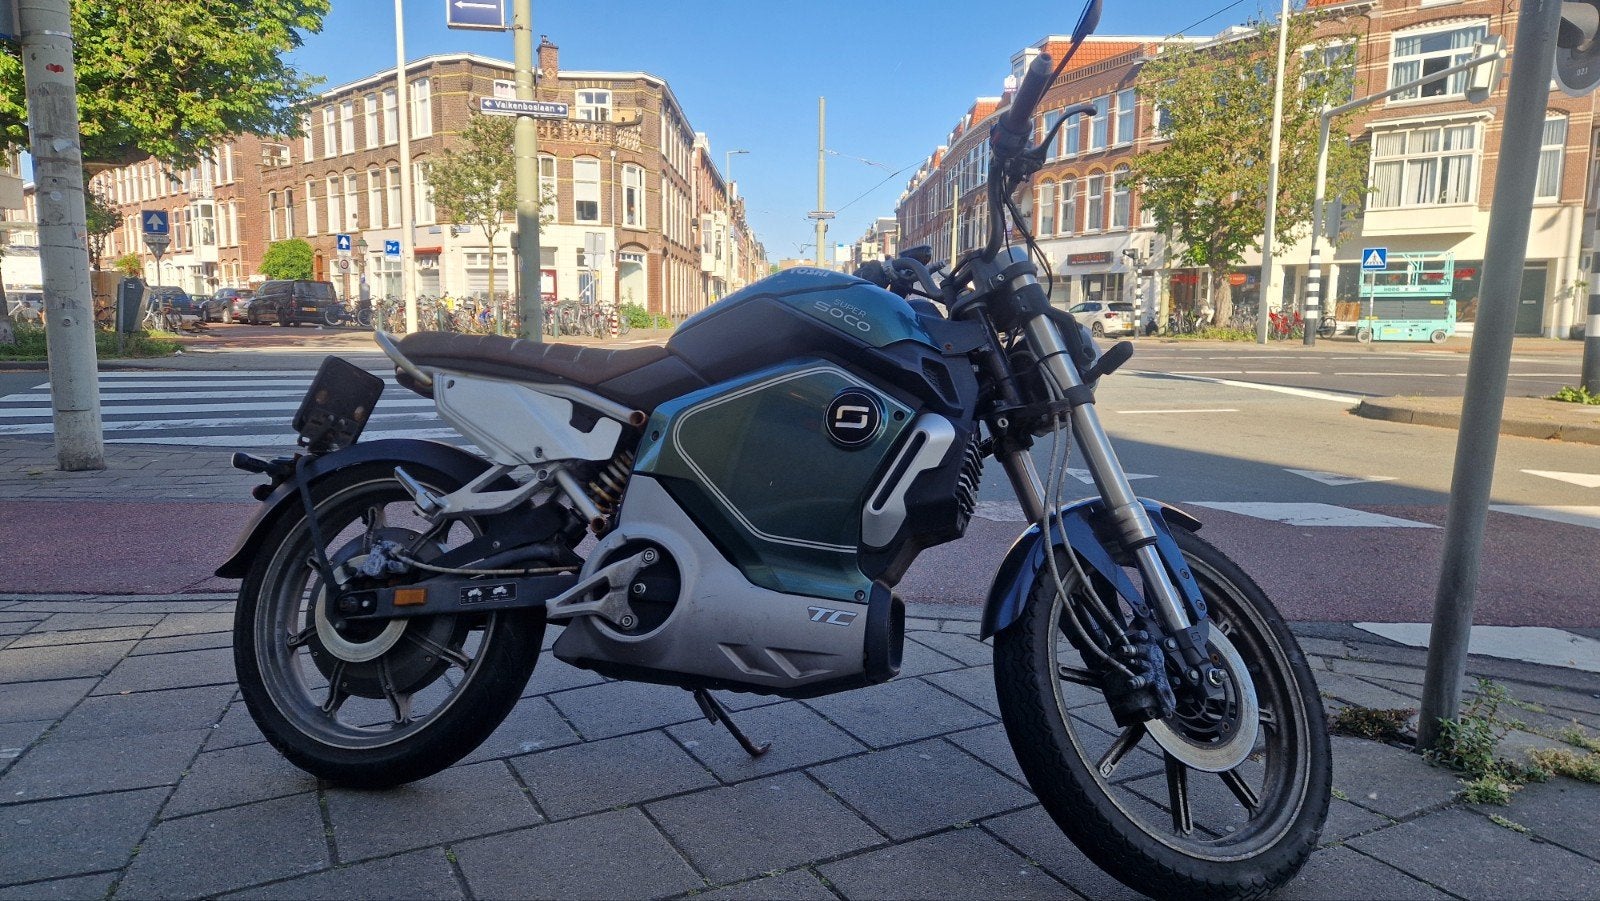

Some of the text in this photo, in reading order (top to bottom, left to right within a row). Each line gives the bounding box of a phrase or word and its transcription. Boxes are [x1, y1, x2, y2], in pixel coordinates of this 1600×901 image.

[494, 100, 555, 113] Valkenboslaan
[814, 301, 871, 332] SOCO
[834, 299, 867, 318] SUPER
[807, 605, 858, 626] TC
